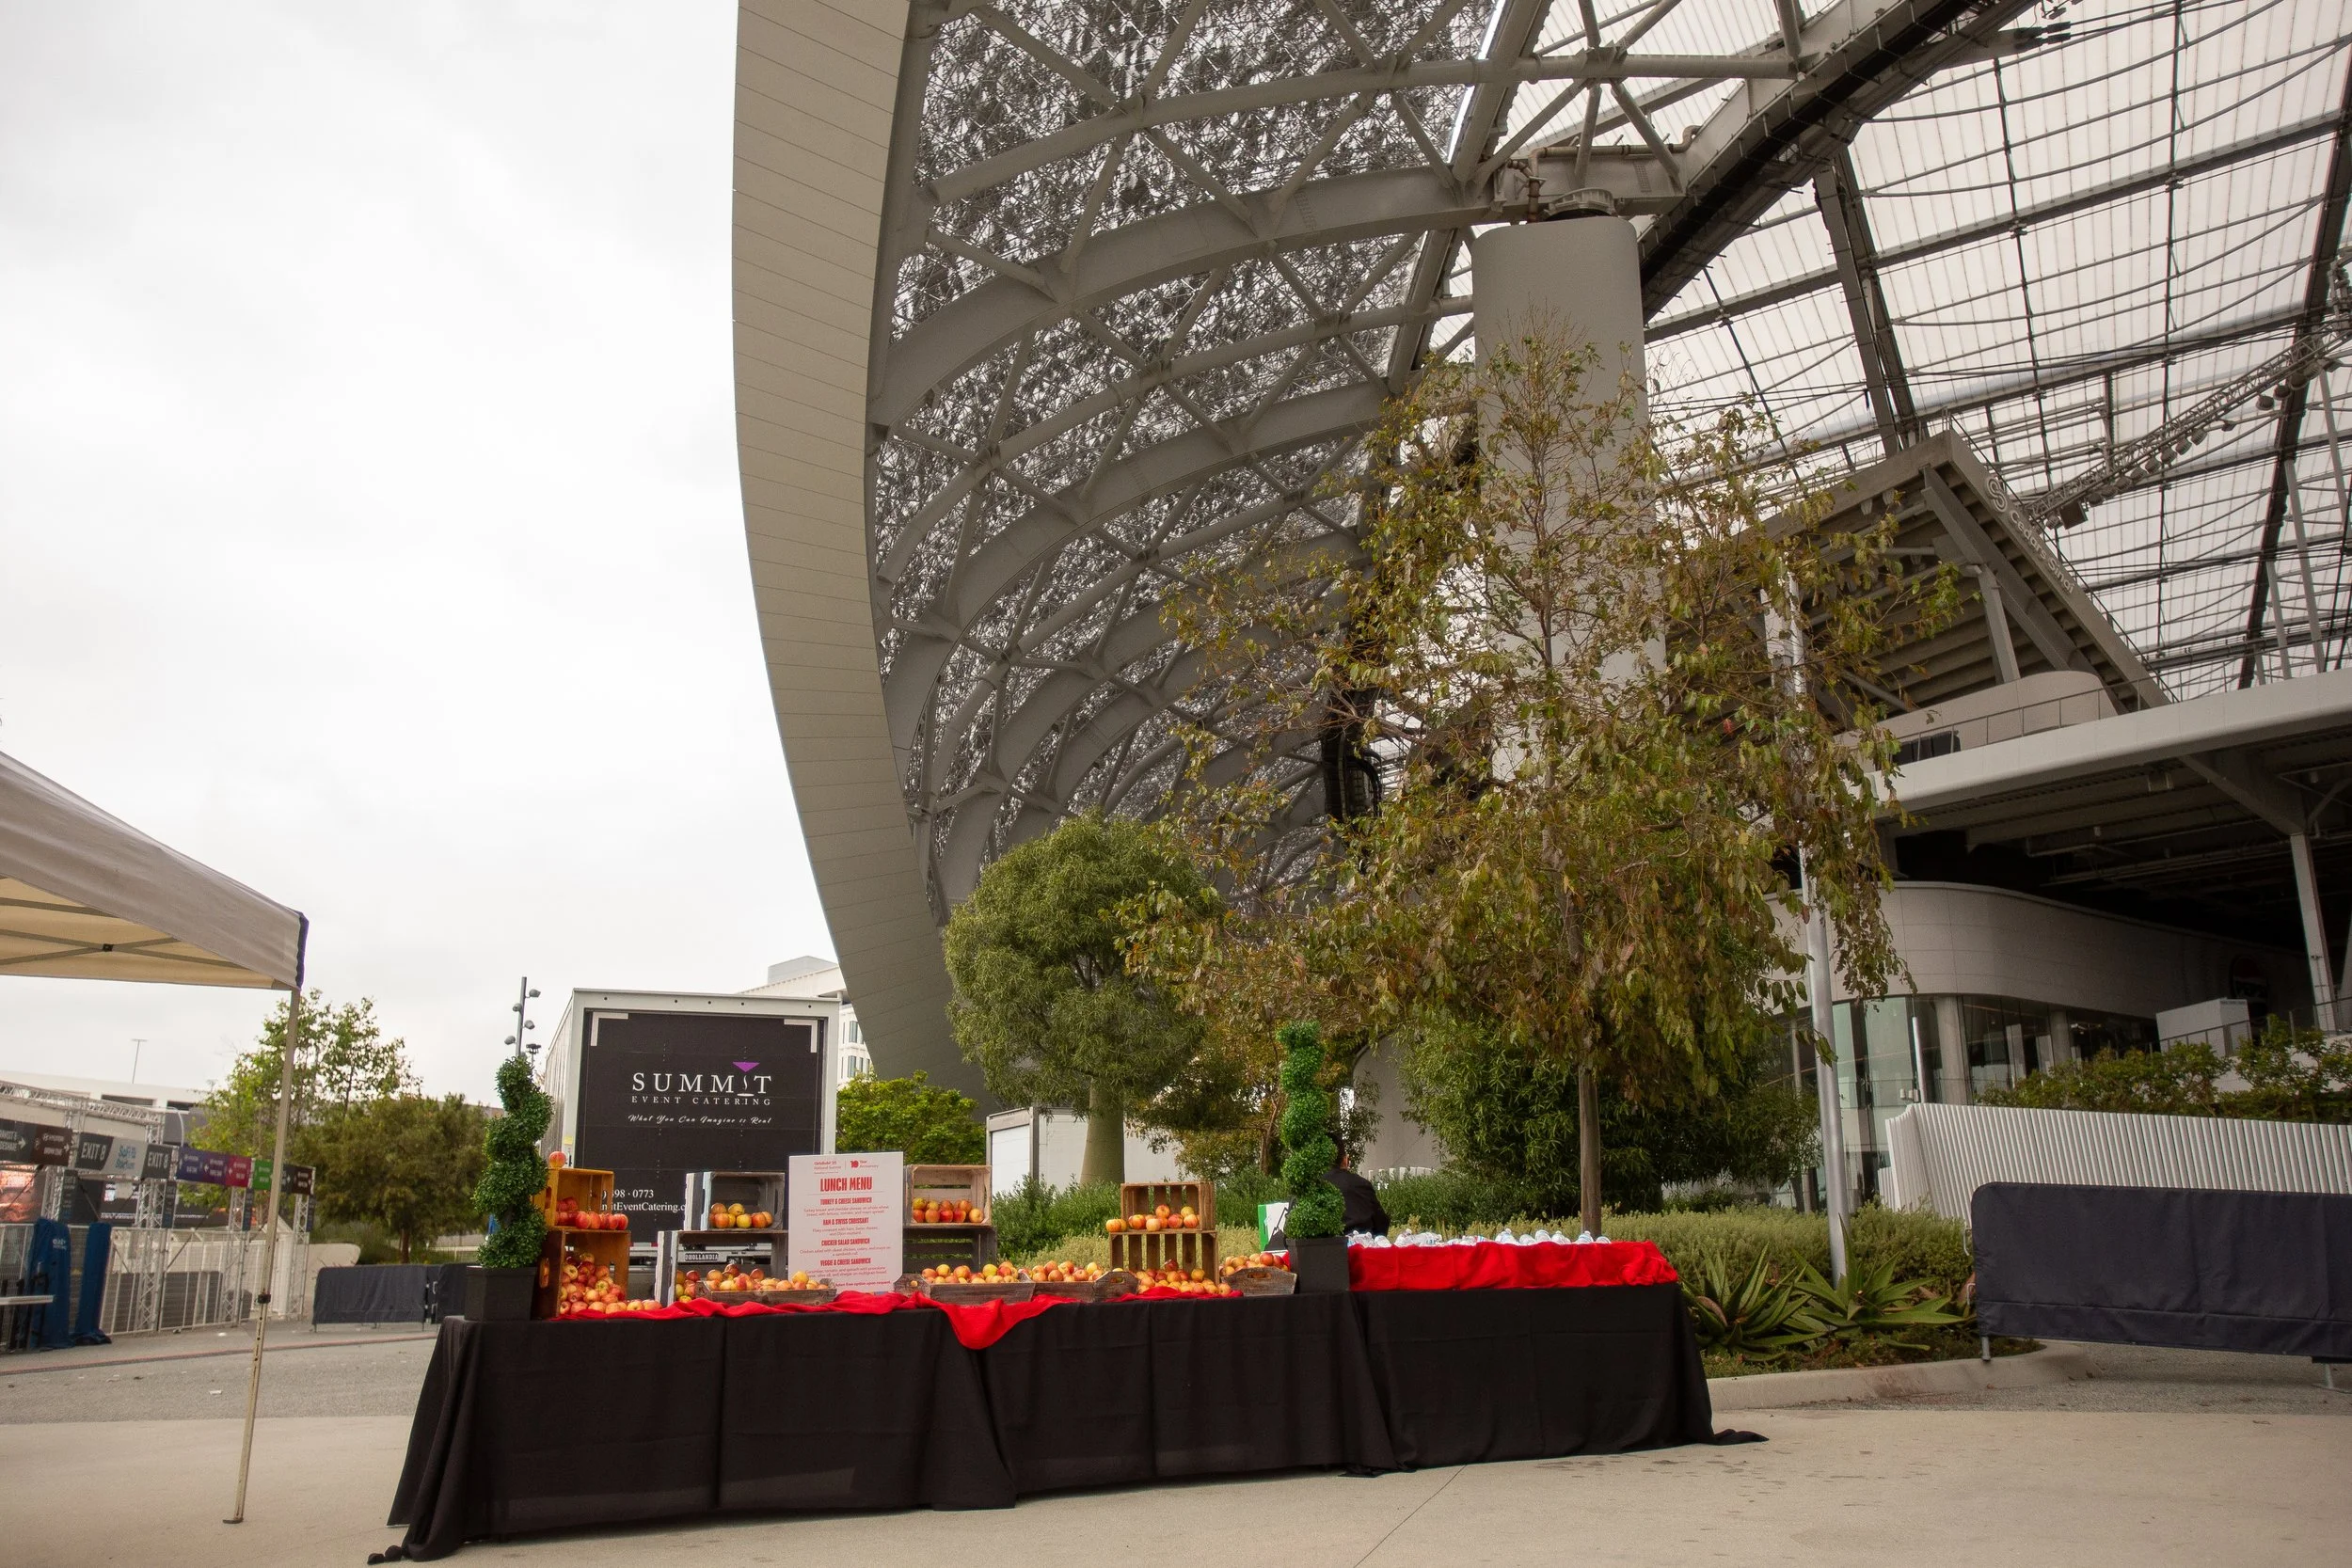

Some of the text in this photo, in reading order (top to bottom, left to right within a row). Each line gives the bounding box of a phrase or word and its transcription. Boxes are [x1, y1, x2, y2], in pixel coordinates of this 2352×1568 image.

[2048, 558, 2074, 594] Sinai
[692, 1097, 771, 1106] CATERING
[628, 1114, 653, 1122] What
[657, 1115, 674, 1124] You
[678, 1115, 696, 1123] Can
[700, 1116, 736, 1125] Imagine
[81, 1142, 98, 1159] EXIT
[99, 1146, 106, 1160] 8
[148, 1151, 164, 1168] EXIT
[820, 1177, 872, 1192] LUNCH MENU
[633, 1189, 654, 1198] 0773
